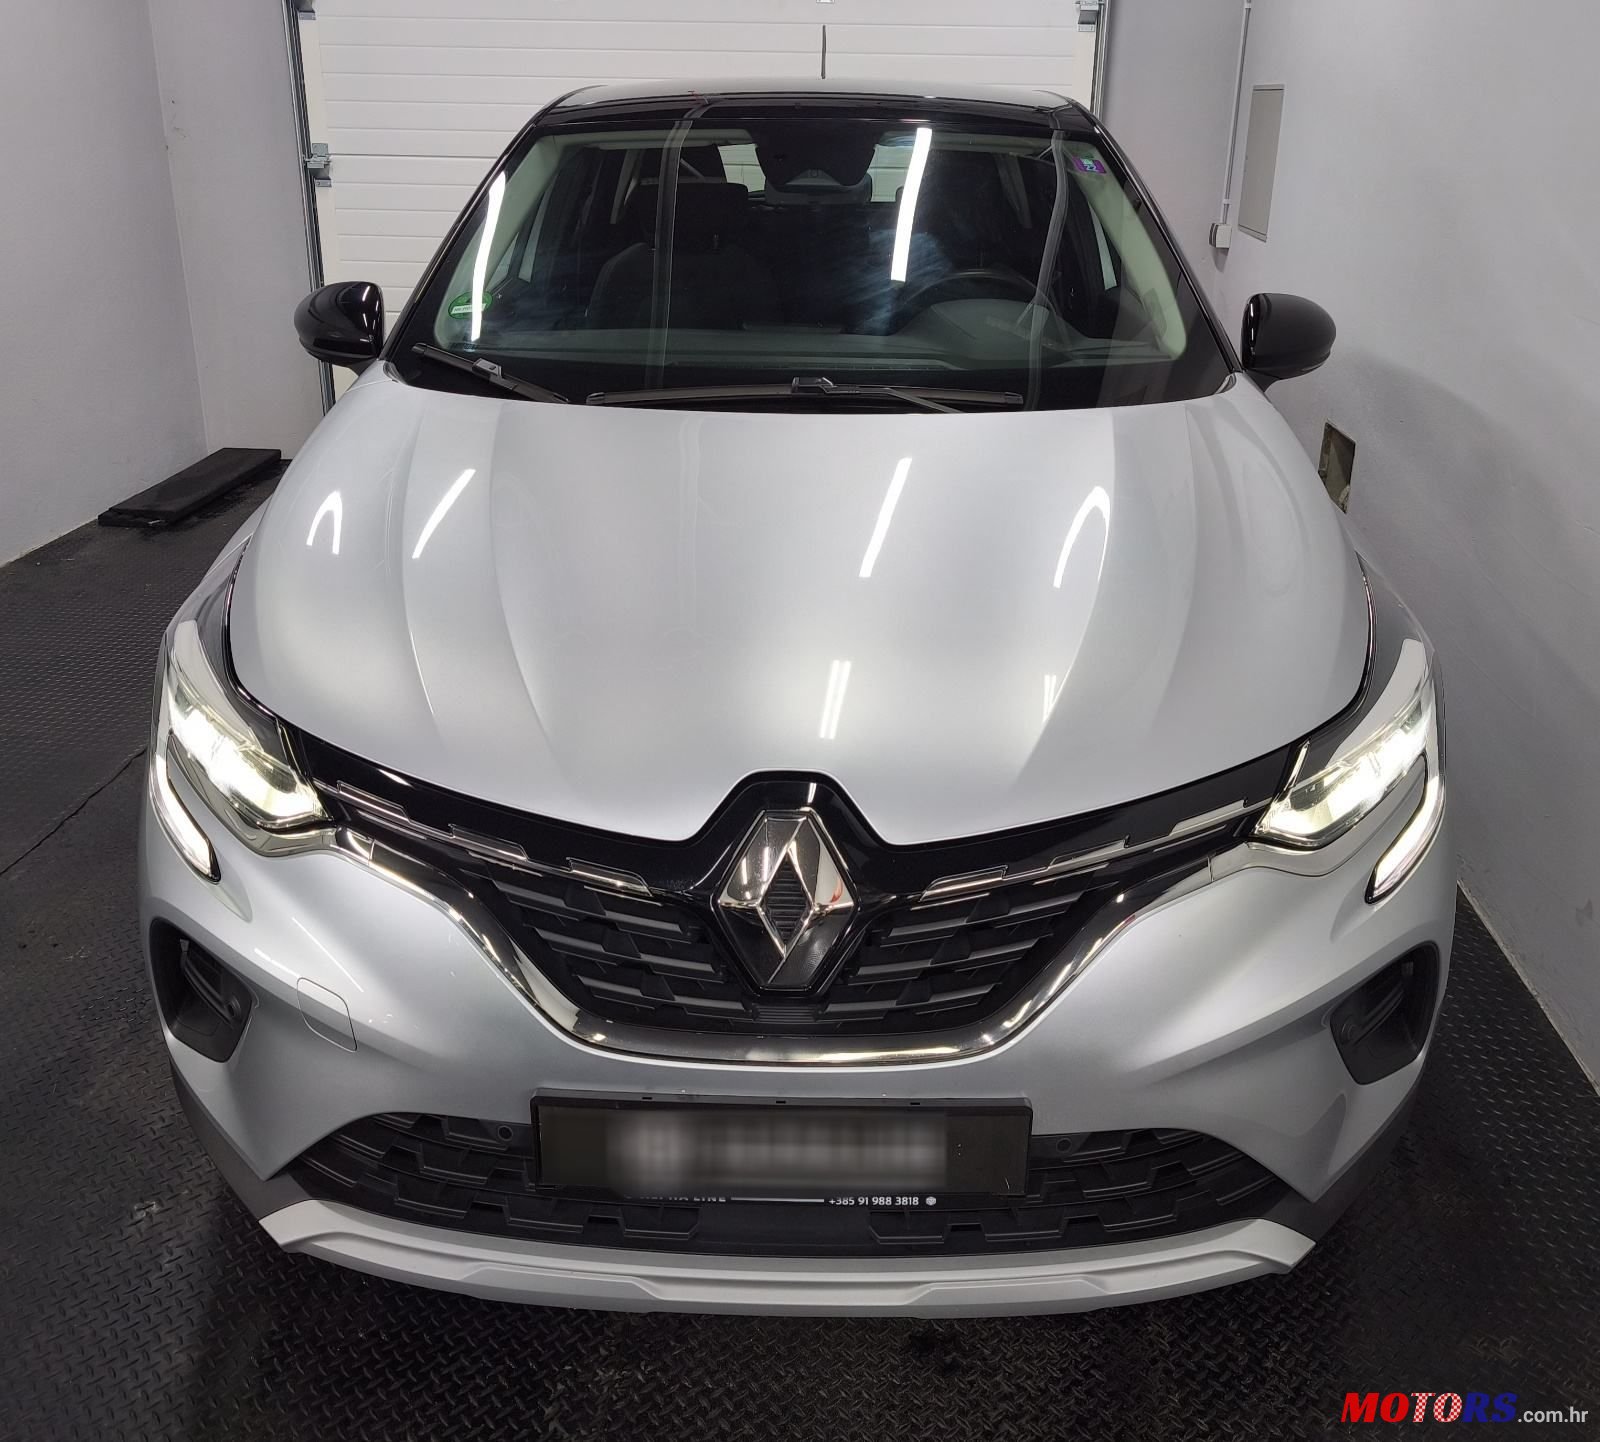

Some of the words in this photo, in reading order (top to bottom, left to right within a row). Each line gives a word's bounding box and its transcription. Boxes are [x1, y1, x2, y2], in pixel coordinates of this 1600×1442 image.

[828, 1197, 855, 1206] +385
[857, 1196, 869, 1206] 91
[871, 1196, 892, 1206] 988
[894, 1196, 919, 1206] 3818
